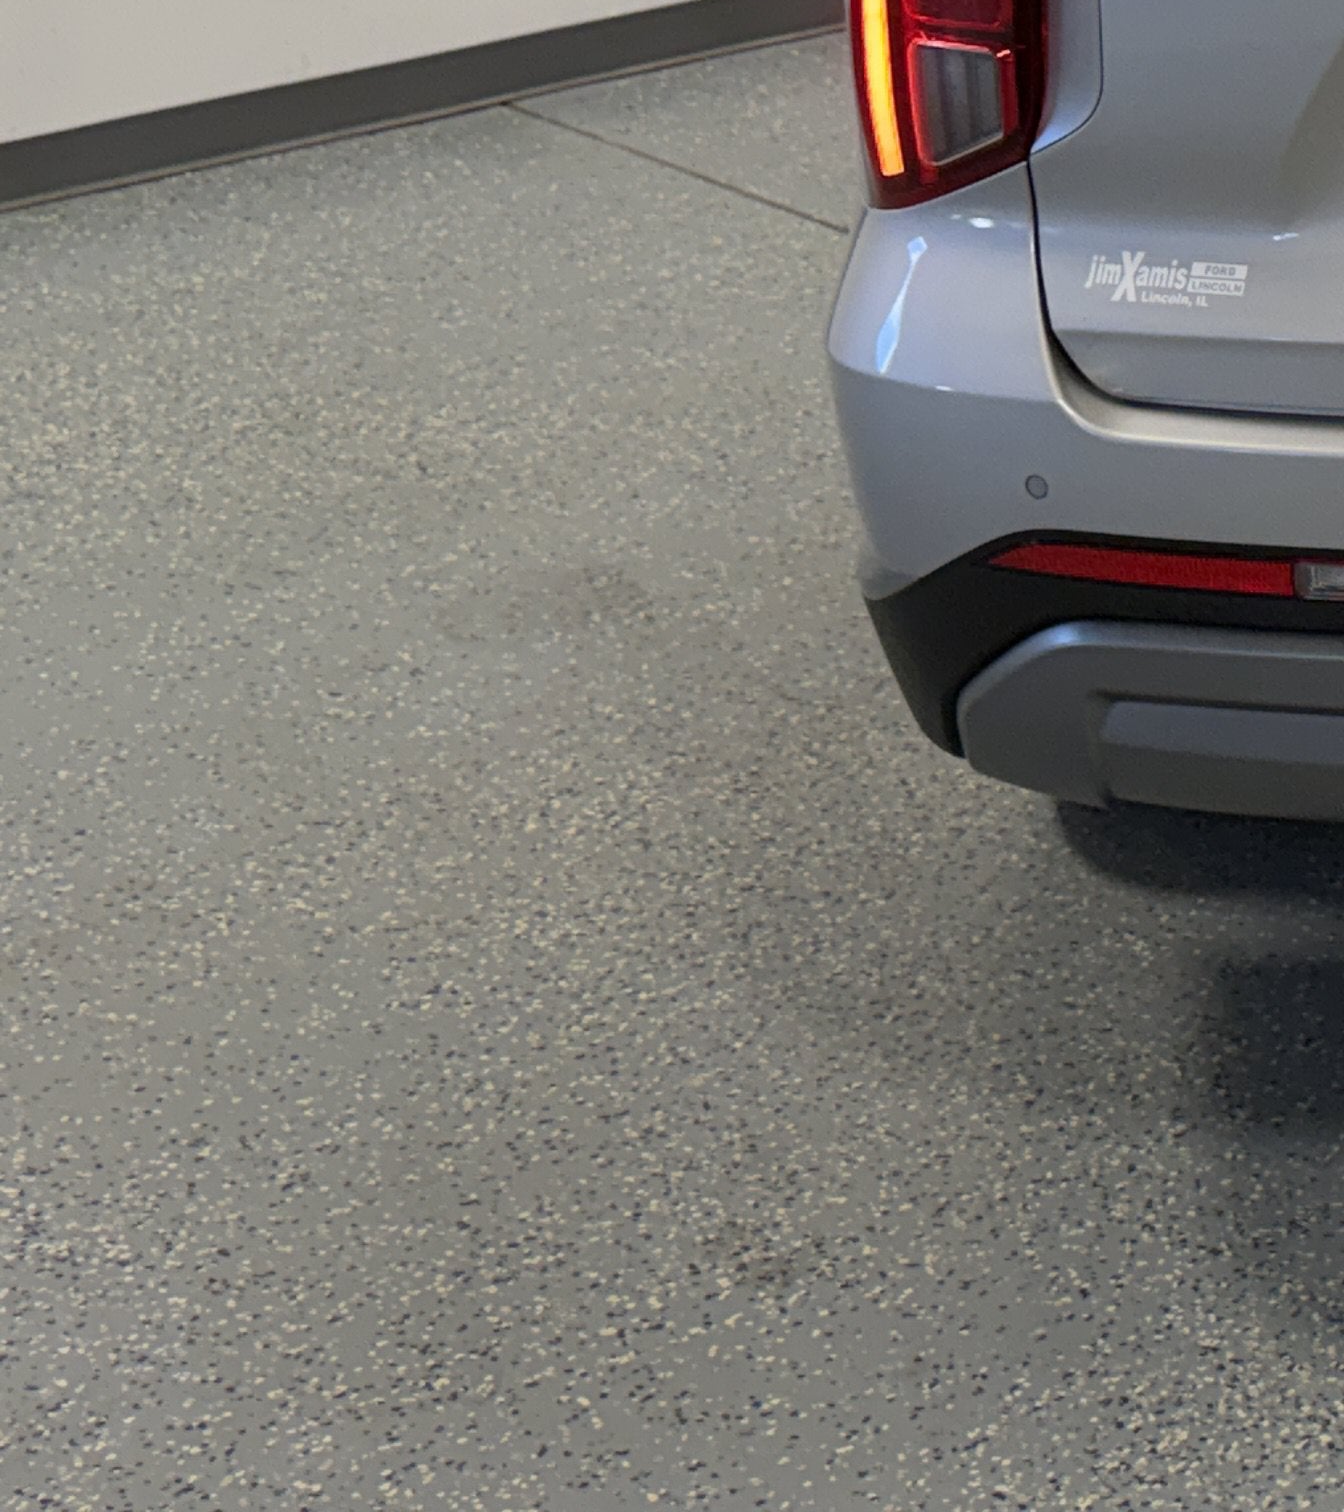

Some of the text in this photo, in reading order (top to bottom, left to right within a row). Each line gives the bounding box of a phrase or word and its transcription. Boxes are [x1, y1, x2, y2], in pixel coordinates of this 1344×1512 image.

[1205, 265, 1236, 275] FORD
[1191, 281, 1242, 292] LINCOLN
[1142, 291, 1208, 307] Lincoln, IL
